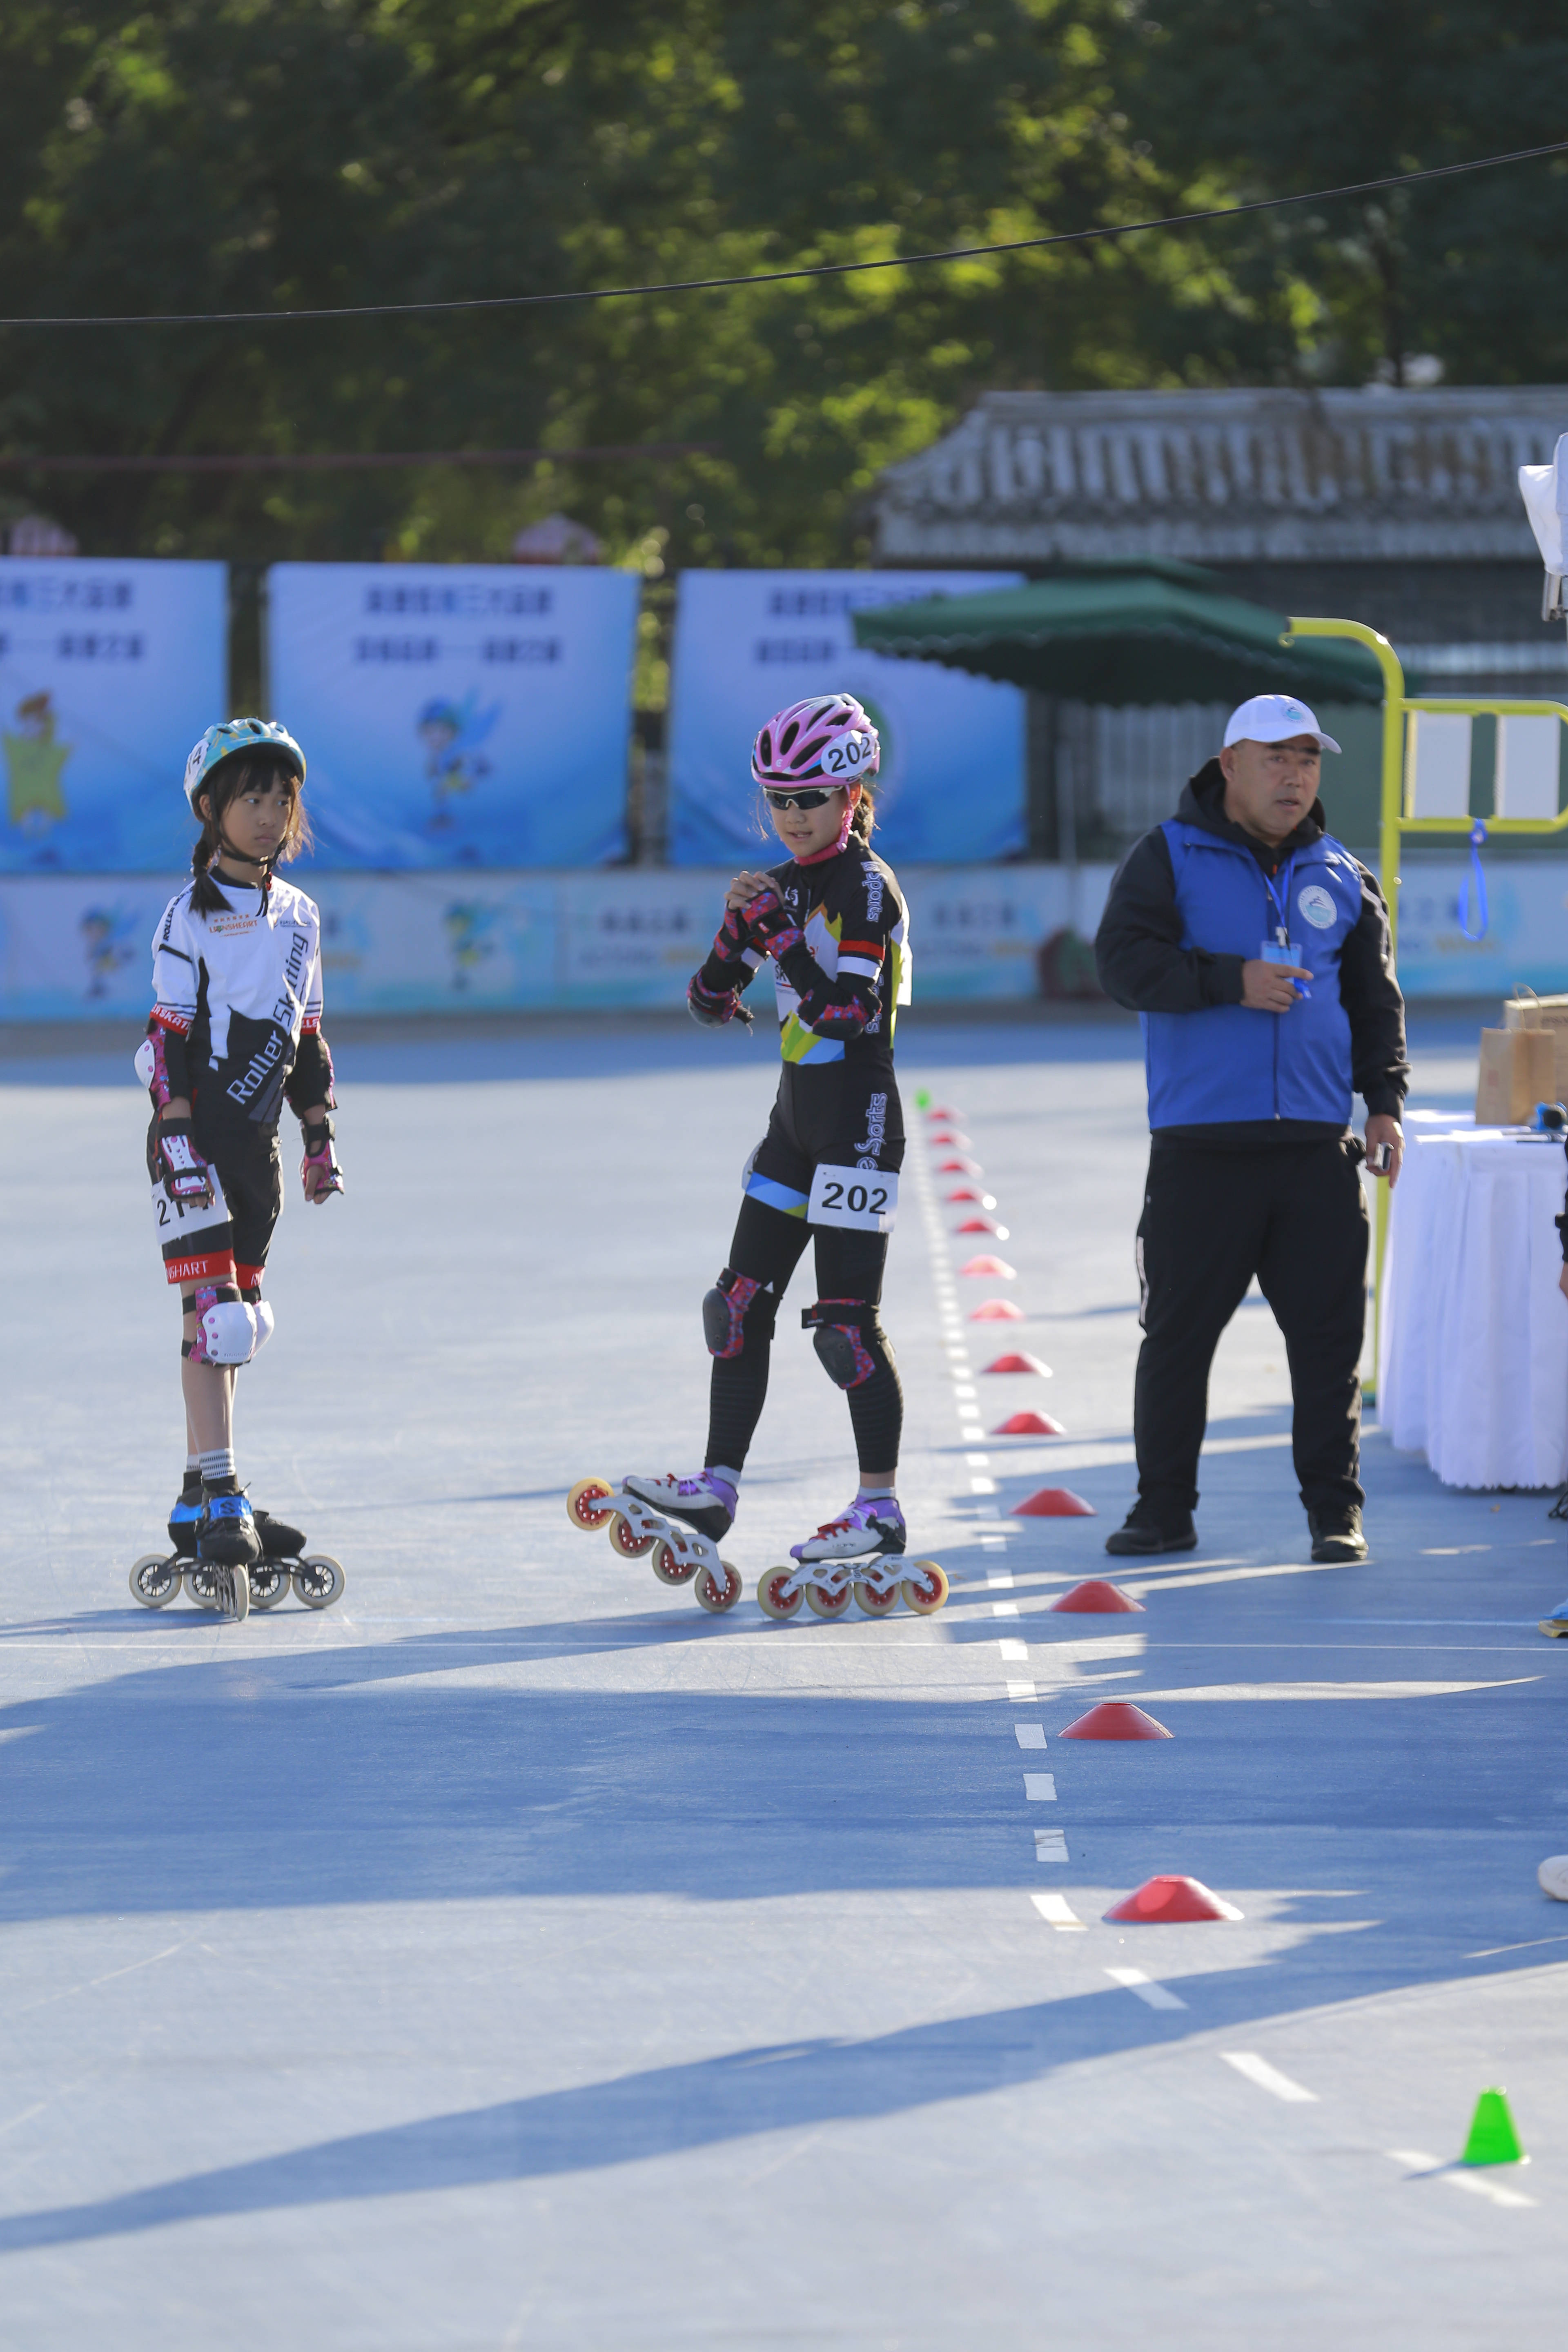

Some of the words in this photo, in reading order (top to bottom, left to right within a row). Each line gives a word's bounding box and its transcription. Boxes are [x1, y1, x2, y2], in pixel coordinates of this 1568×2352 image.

[185, 746, 203, 779] 14
[828, 737, 871, 773] 202
[226, 1029, 283, 1105] Roller
[854, 1093, 888, 1156] Sports
[157, 1197, 209, 1226] 21
[822, 1182, 888, 1214] 202
